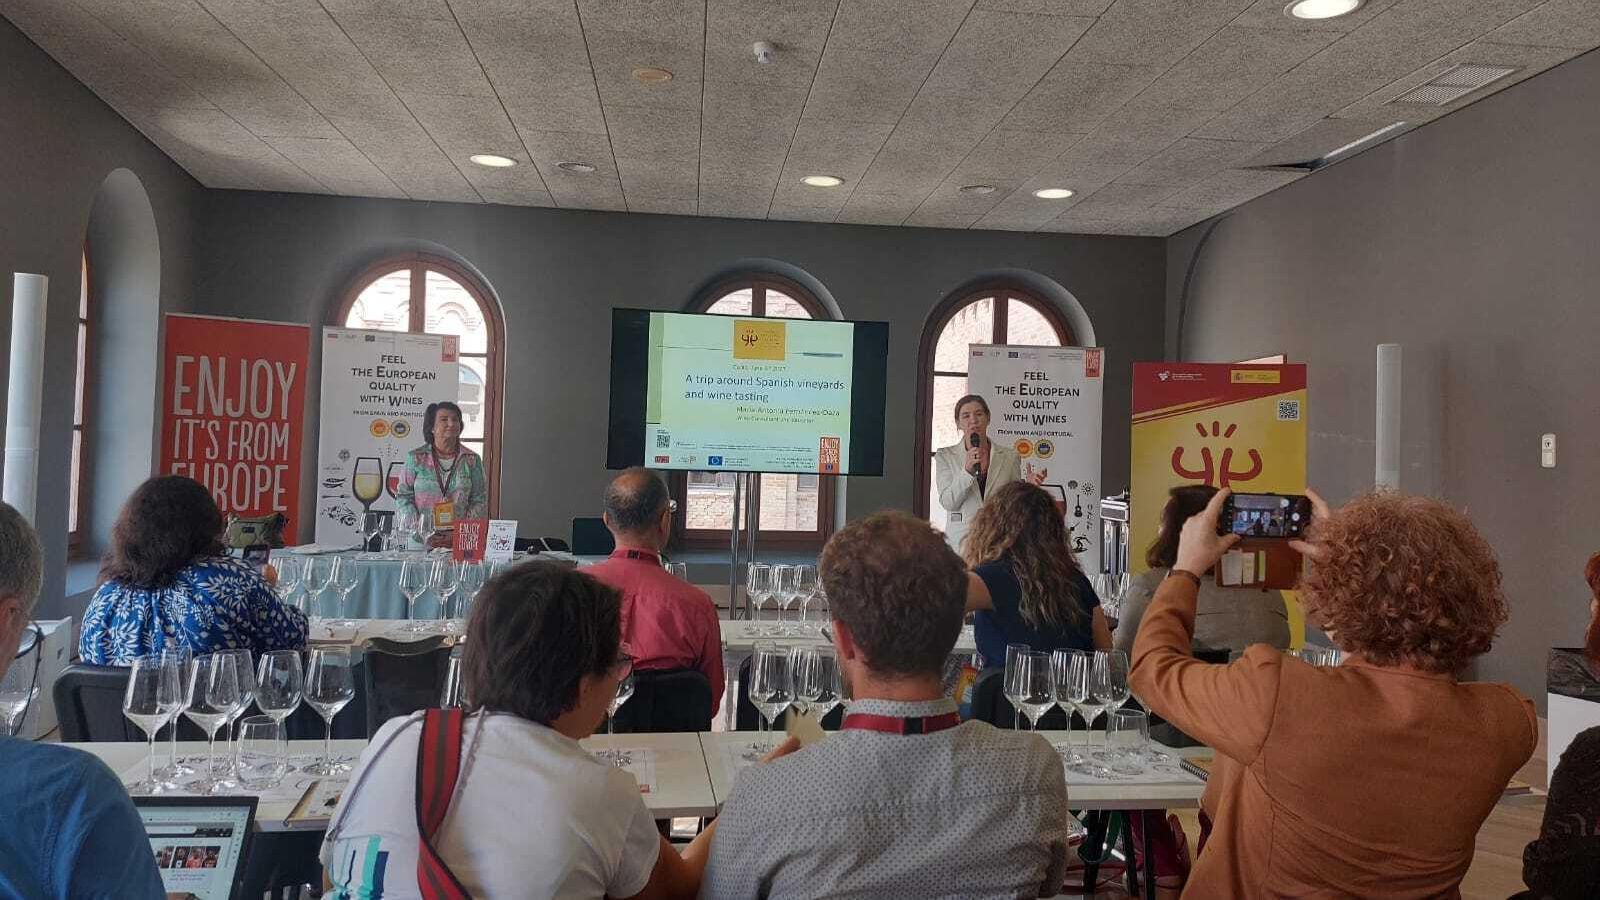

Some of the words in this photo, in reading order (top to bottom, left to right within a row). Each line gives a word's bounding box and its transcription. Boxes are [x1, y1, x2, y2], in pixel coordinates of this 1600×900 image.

[381, 355, 406, 364] FEEL
[352, 368, 373, 377] THE
[376, 366, 436, 380] EUROPEAN
[1024, 371, 1048, 380] FEEL
[173, 355, 297, 420] ENJOY
[369, 381, 417, 392] QUALITY
[685, 374, 693, 384] A
[696, 374, 714, 385] trip
[717, 376, 753, 385] around
[757, 377, 794, 389] Spanish
[797, 379, 845, 391] vineyards
[685, 389, 704, 399] and
[708, 390, 732, 400] wine
[735, 391, 769, 403] tasting
[995, 386, 1017, 395] THE
[1019, 383, 1080, 397] EUROPEAN
[360, 395, 385, 404] WITH
[388, 396, 423, 407] WINES
[1013, 400, 1060, 410] QUALITY
[1004, 413, 1028, 422] WITH
[1032, 414, 1067, 426] WINES
[174, 419, 220, 460] IT'S
[227, 420, 290, 461] FROM
[821, 438, 839, 449] ENJOY
[459, 523, 480, 534] ENJOY
